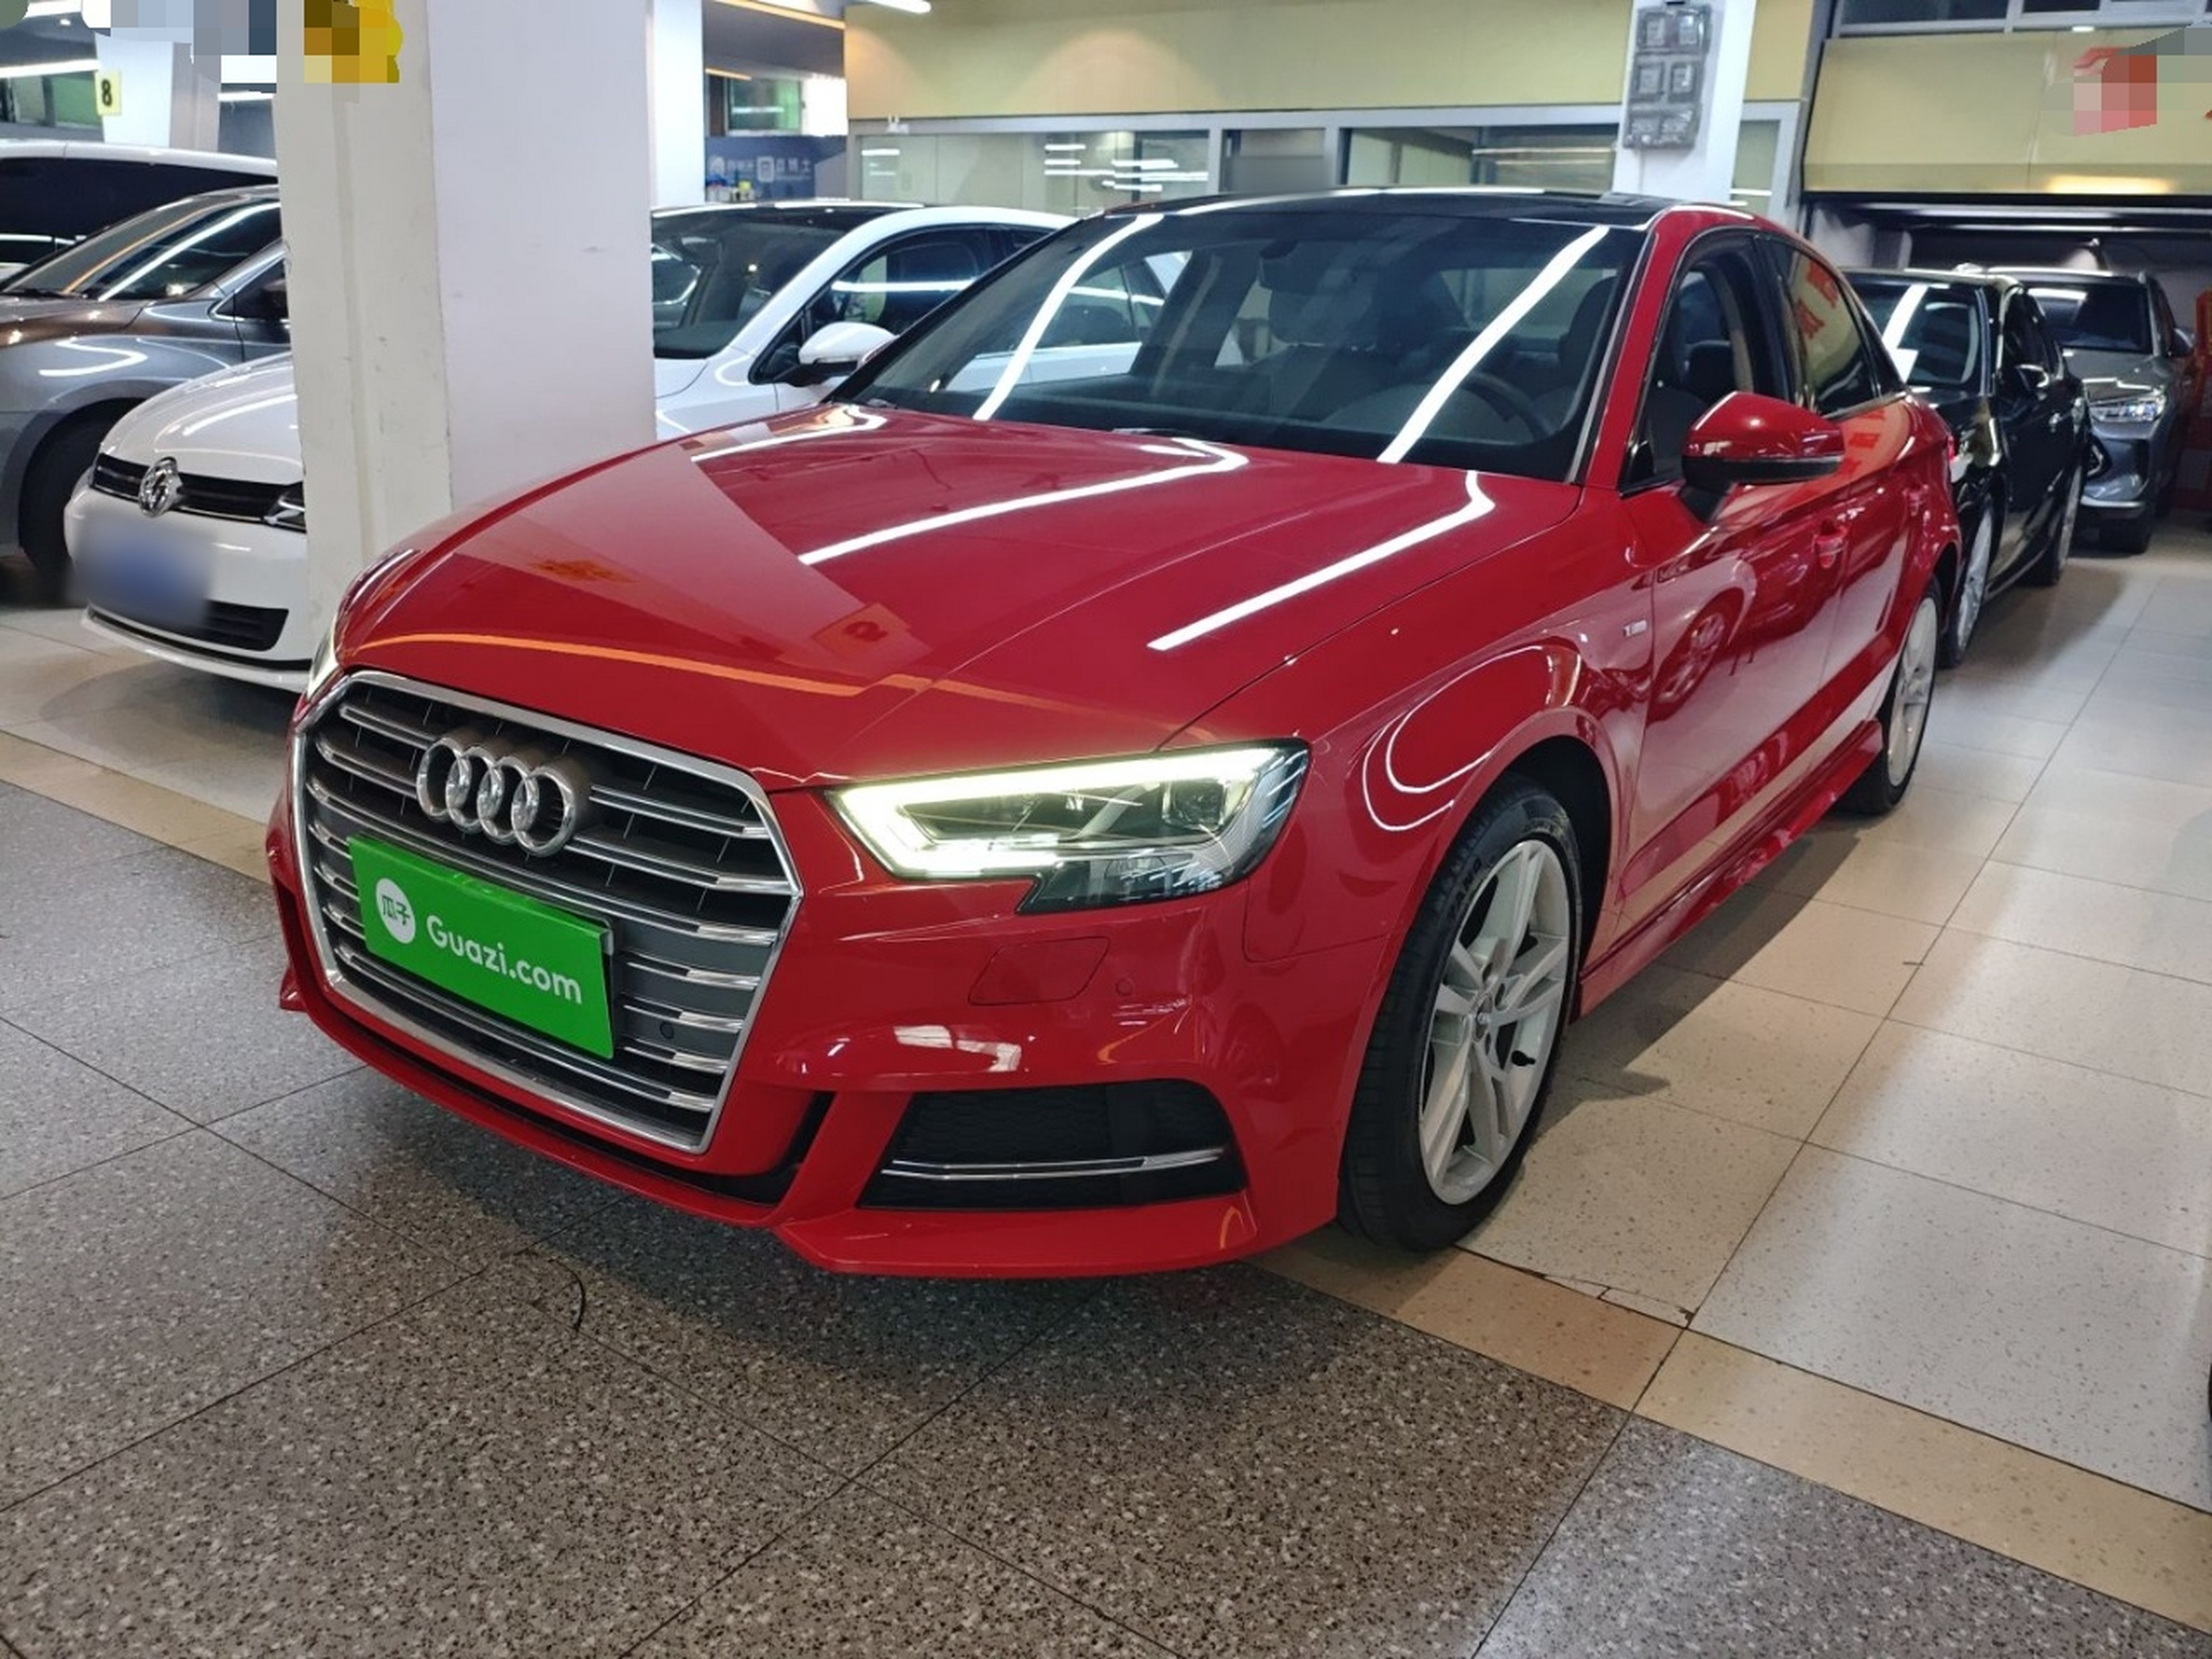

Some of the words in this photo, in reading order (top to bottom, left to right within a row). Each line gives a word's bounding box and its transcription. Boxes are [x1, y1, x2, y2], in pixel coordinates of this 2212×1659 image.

[101, 78, 112, 107] 8
[382, 895, 411, 926] 瓜子
[426, 915, 582, 1005] Guazi.com
